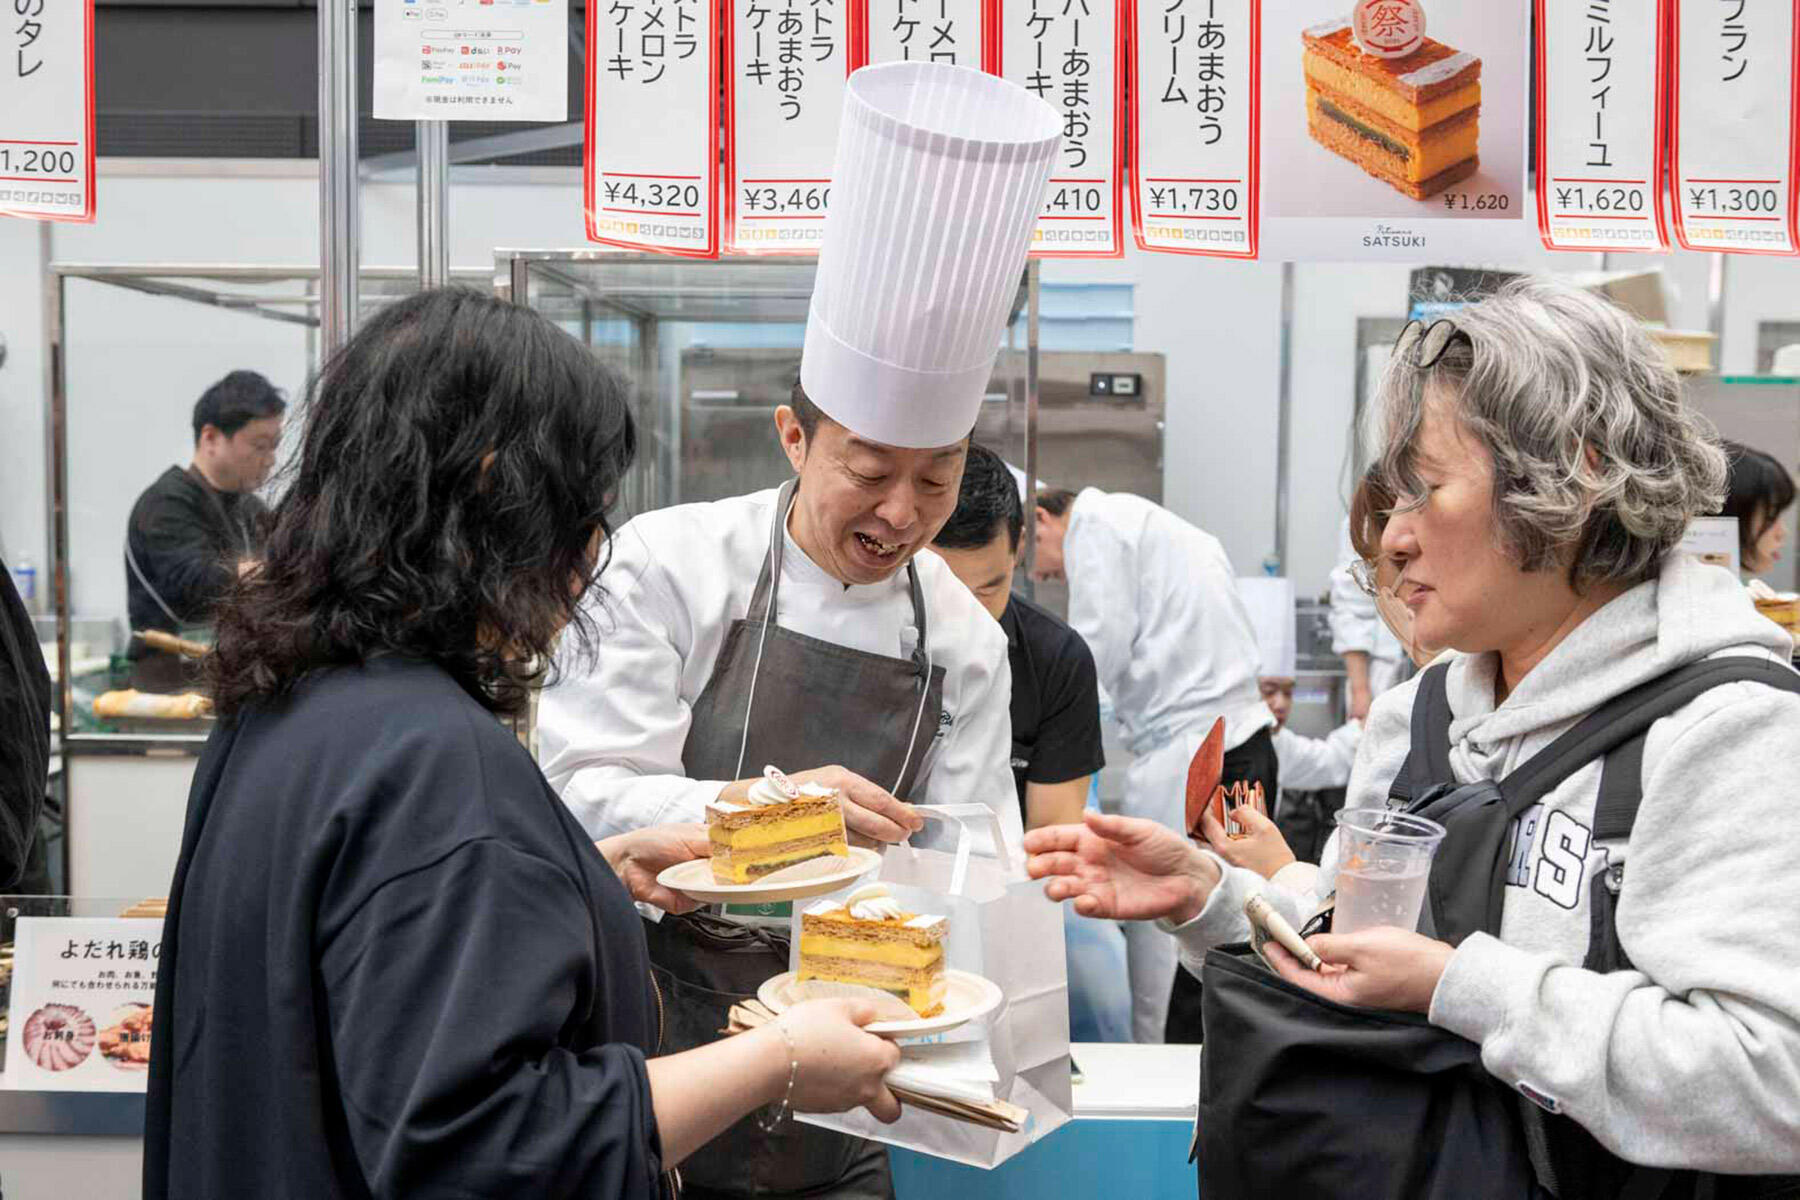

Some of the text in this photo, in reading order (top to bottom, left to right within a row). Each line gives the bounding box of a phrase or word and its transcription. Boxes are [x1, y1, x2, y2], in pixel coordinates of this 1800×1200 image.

[673, 0, 697, 59] トラ
[809, 0, 834, 62] トラ
[1371, 5, 1409, 37] 祭
[641, 0, 665, 83] メロン
[778, 0, 804, 121] あまおう
[1584, 0, 1614, 167] ミルフィーユ
[604, 181, 700, 208] ¥4,320
[1150, 187, 1238, 213] ¥1,730
[1556, 187, 1644, 213] ¥1,620
[1689, 188, 1778, 213] ¥1,300
[1362, 236, 1426, 247] SATSUKI
